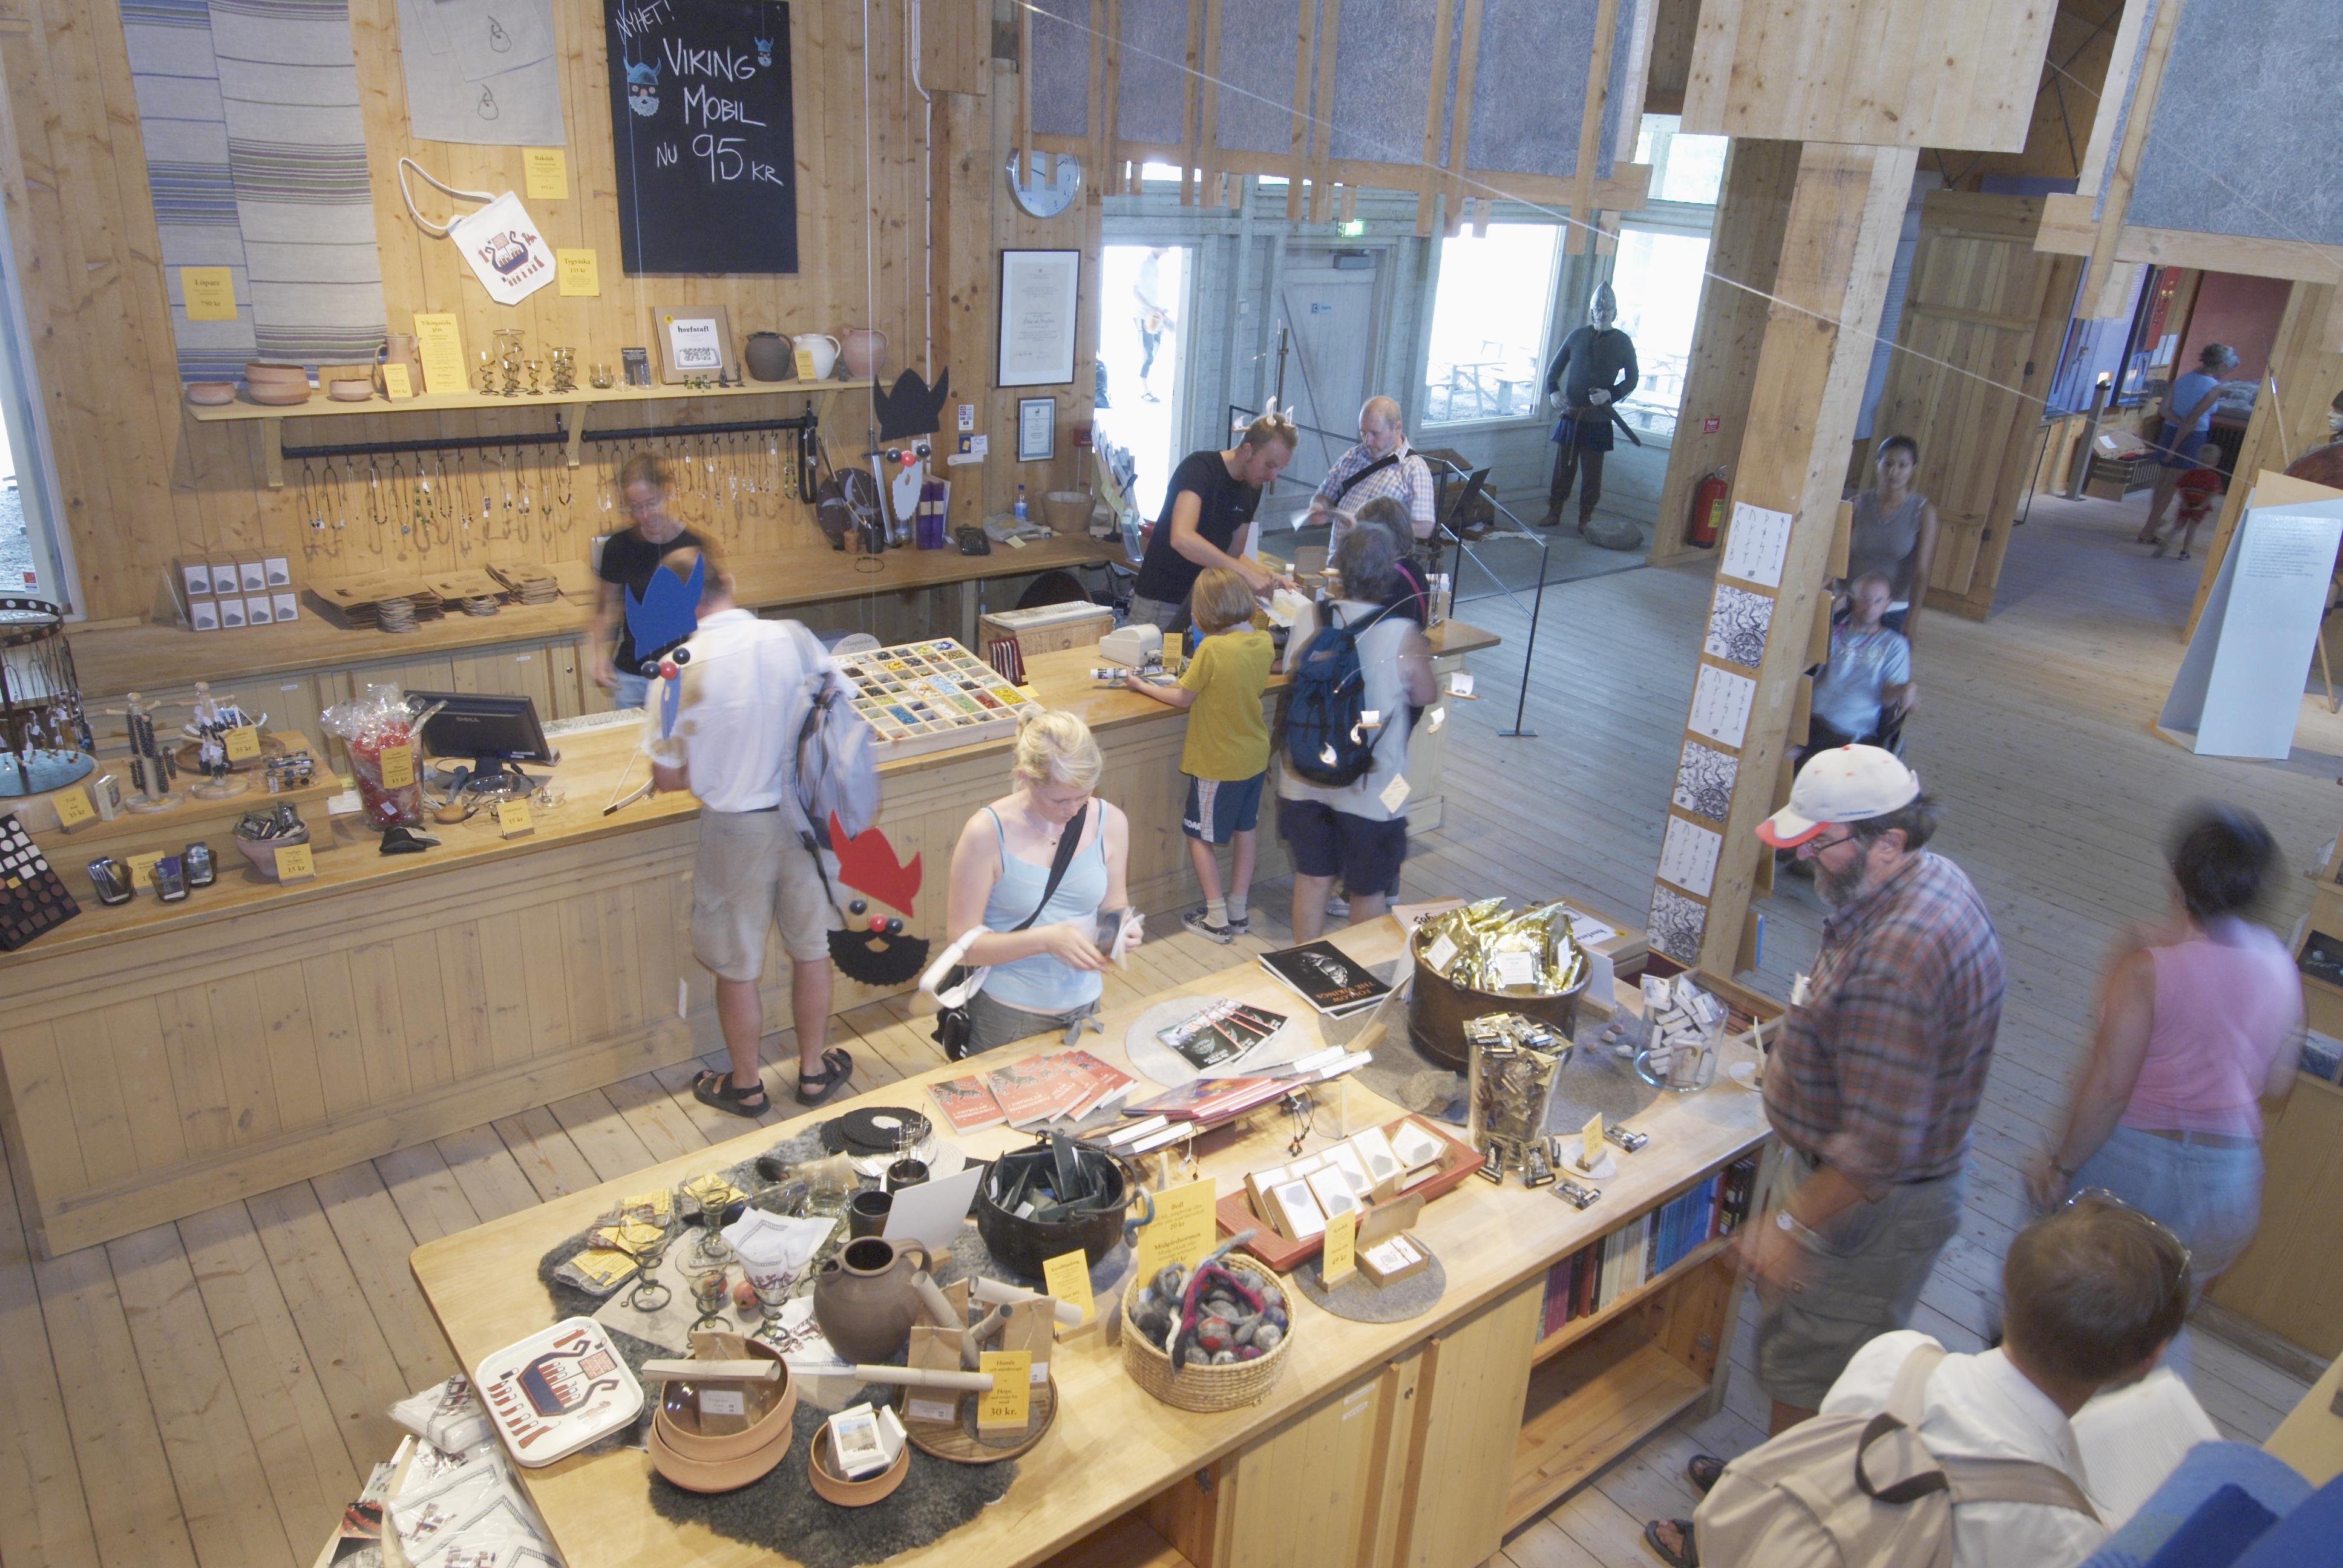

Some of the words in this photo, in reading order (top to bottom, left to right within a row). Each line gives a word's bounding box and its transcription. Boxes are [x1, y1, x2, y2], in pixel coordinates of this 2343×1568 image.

[663, 38, 756, 82] VIKING
[684, 84, 767, 129] MOBIL
[657, 142, 678, 168] NU
[692, 134, 746, 183] 95
[752, 161, 784, 186] KR
[1316, 987, 1355, 999] VIKINGS
[990, 1408, 1002, 1416] 30
